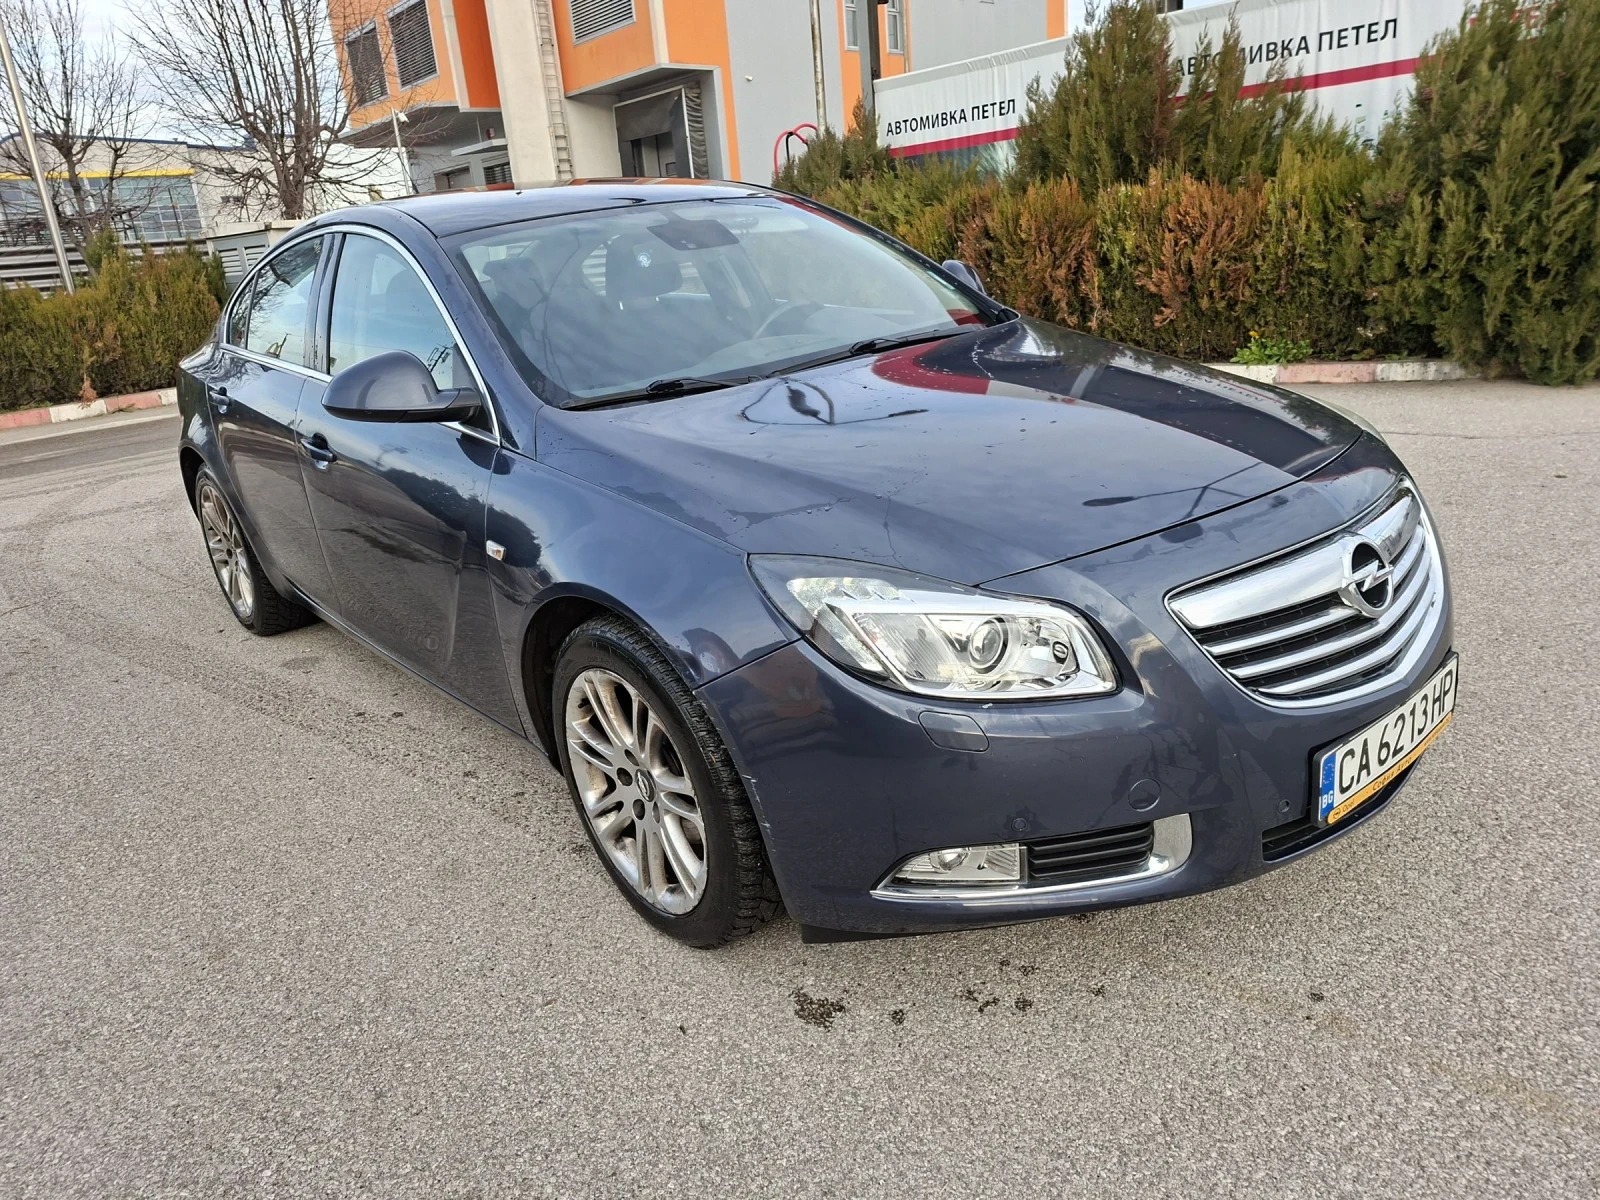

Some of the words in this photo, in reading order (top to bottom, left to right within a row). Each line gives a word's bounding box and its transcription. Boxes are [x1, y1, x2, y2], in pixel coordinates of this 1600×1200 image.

[1318, 18, 1398, 52] ПЕТЕЛ
[886, 108, 968, 137] АВТОМИВКА
[971, 99, 1016, 122] ПЕТЕЛ
[1322, 790, 1334, 809] BG
